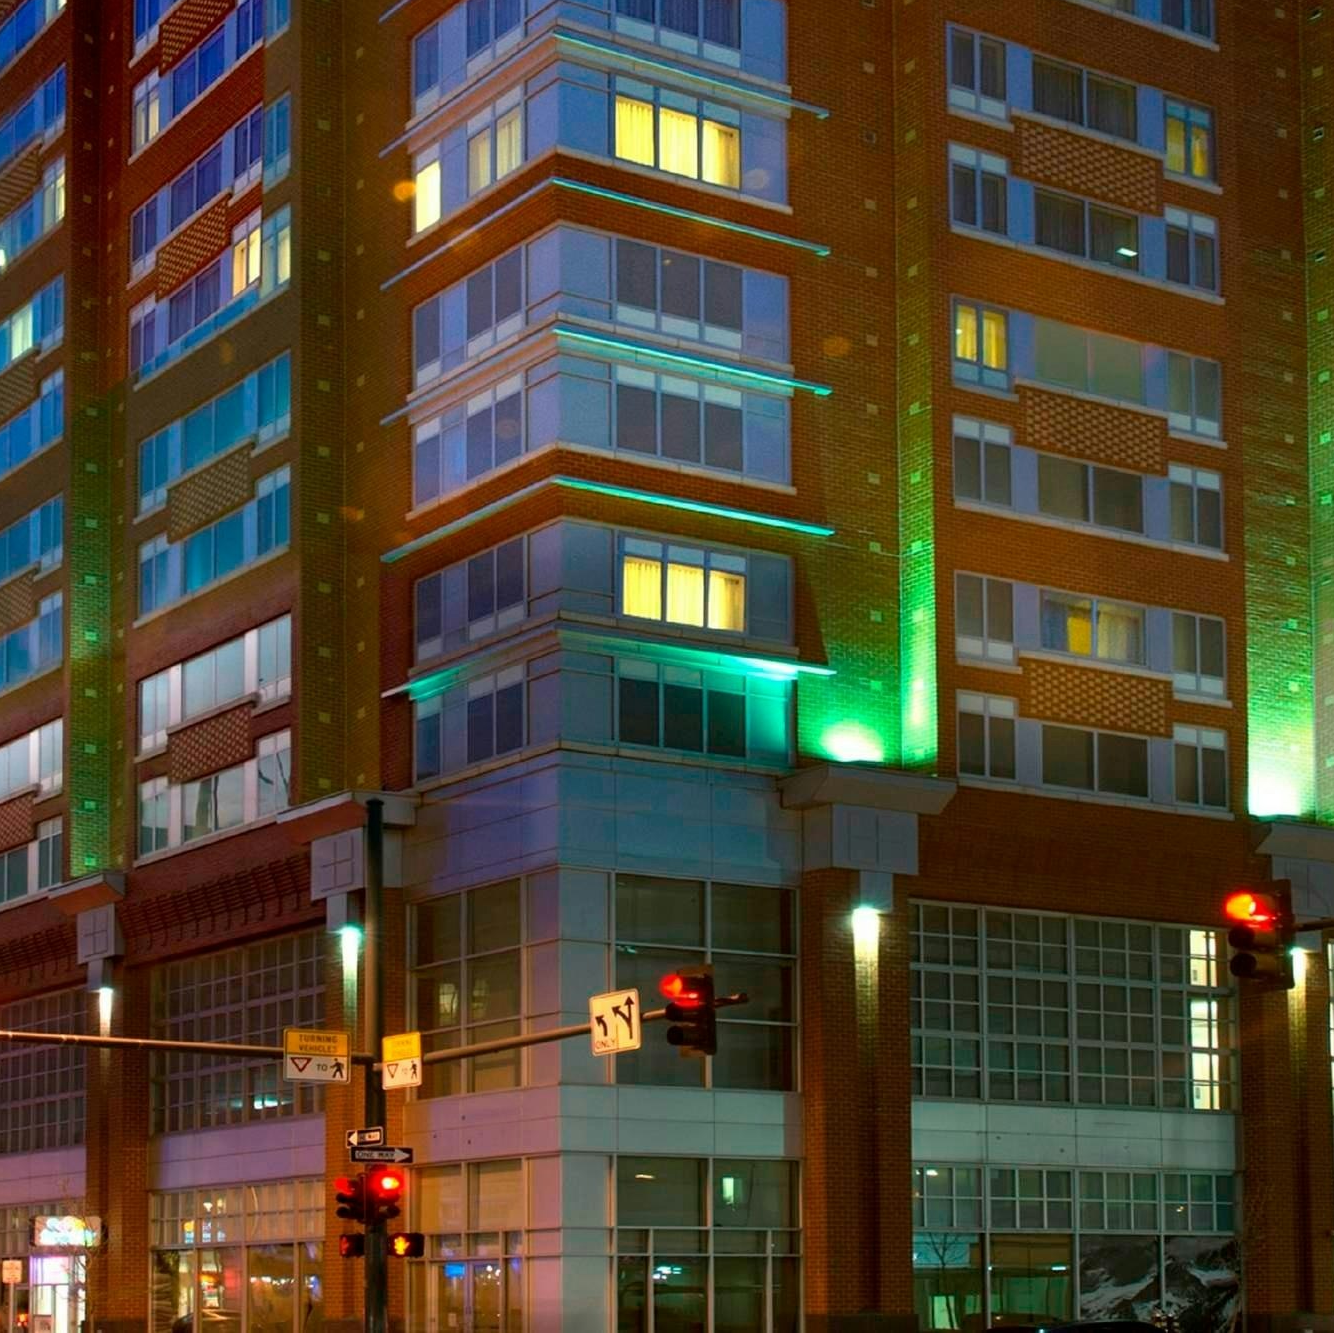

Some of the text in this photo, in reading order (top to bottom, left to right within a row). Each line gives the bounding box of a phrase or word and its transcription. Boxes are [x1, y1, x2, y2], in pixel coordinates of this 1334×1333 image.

[298, 1034, 338, 1043] TURNING
[595, 1037, 616, 1050] ONLY
[298, 1045, 338, 1053] VEHICLES
[316, 1063, 328, 1072] TO
